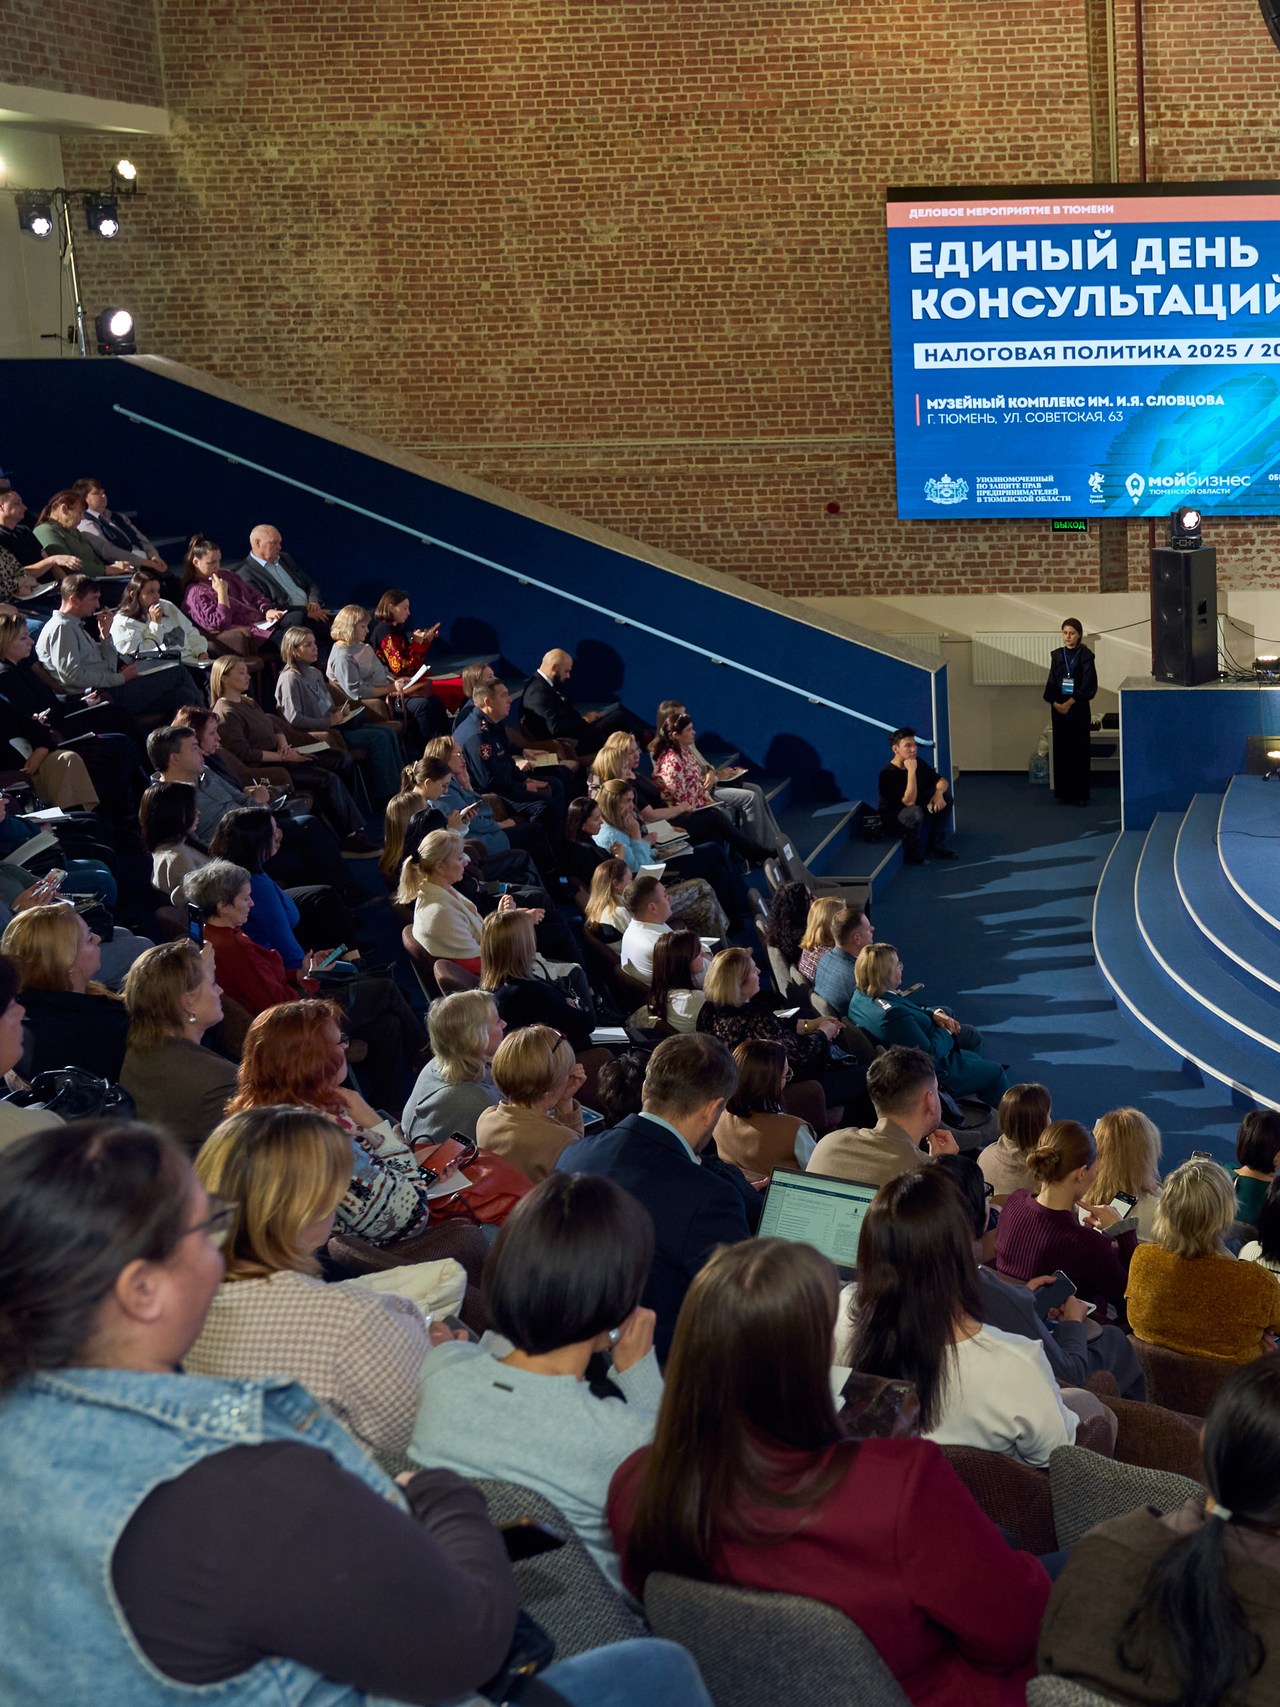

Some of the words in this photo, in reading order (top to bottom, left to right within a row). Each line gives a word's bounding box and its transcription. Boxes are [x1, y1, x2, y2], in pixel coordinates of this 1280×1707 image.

[909, 207, 964, 219] ДЕЛОВОЕ
[967, 205, 1050, 216] МЕРОПРИЯТИЕ
[1053, 205, 1060, 214] В
[1063, 204, 1113, 215] ТЮМЕНИ
[910, 229, 1117, 279] ЕДИНЫЙ
[1132, 236, 1258, 275] ДЕНЬ
[925, 346, 1055, 362] НАЛОГОВАЯ
[1063, 344, 1181, 360] ПОЛИТИКА
[1188, 344, 1237, 358] 2025
[927, 395, 1005, 409] МУЗЕЙНЫЙ
[1008, 396, 1085, 408] КОМПЛЕКС
[1088, 396, 1113, 407] ИМ.
[1117, 396, 1143, 407] И.Я.
[1146, 395, 1224, 407] СЛОВЦОВА
[928, 413, 936, 424] Г.
[939, 412, 998, 426] ТЮМЕНЬ,
[1004, 412, 1022, 424] УЛ.
[1025, 412, 1106, 424] СОВЕТСКАЯ,
[1108, 412, 1124, 422] 63
[1149, 487, 1196, 495] ТЮМЕНСКОЙ
[984, 494, 1034, 503] ТЮМЕНСКОЙ
[1054, 521, 1086, 530] ВЫХОД
